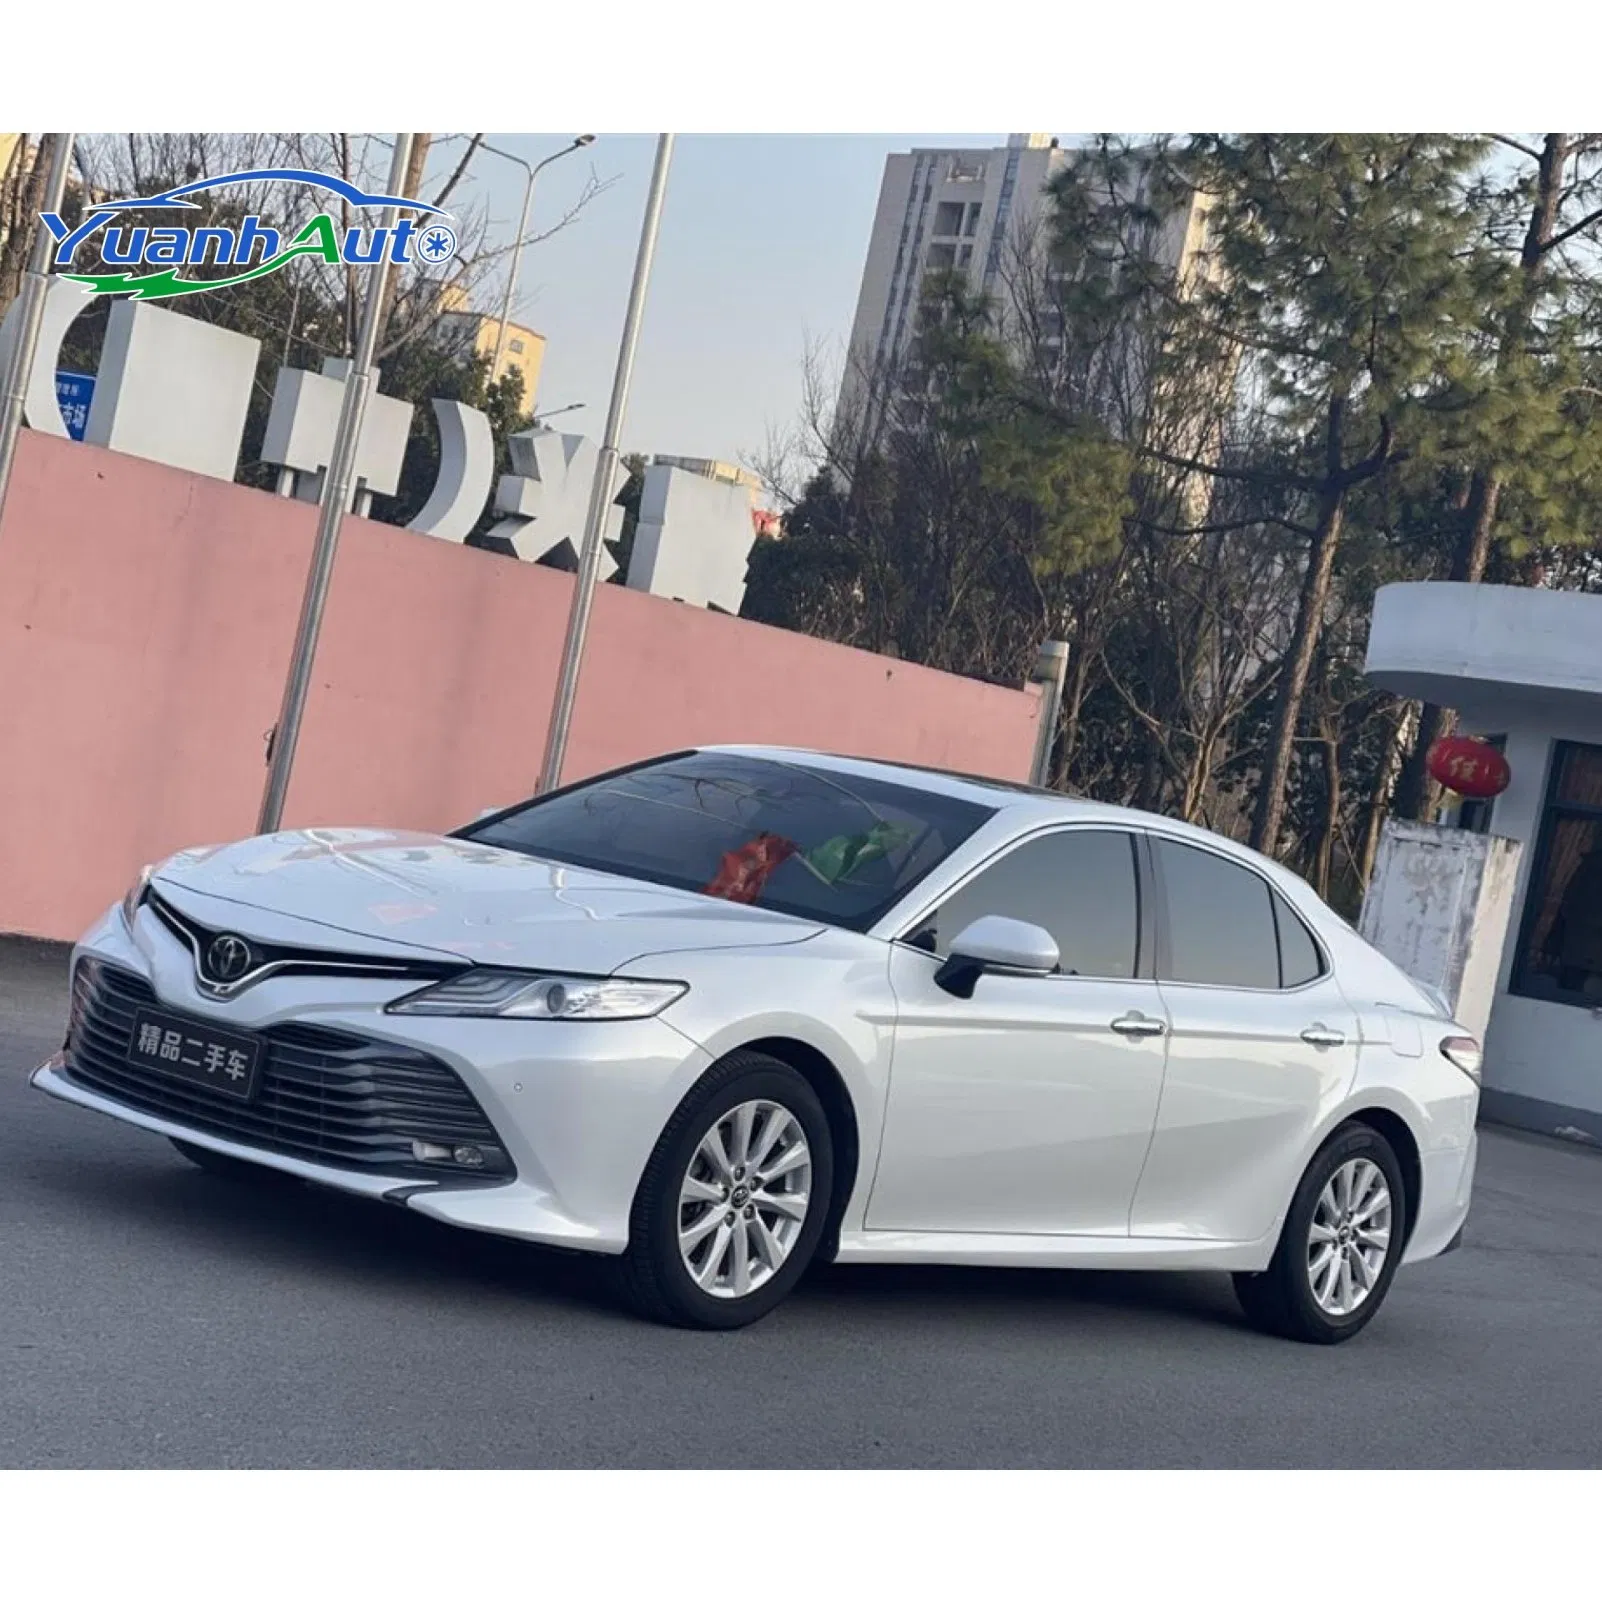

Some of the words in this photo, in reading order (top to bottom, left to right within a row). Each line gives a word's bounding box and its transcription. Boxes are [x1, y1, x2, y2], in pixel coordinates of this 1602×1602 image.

[138, 1022, 249, 1081] 精品二手车
